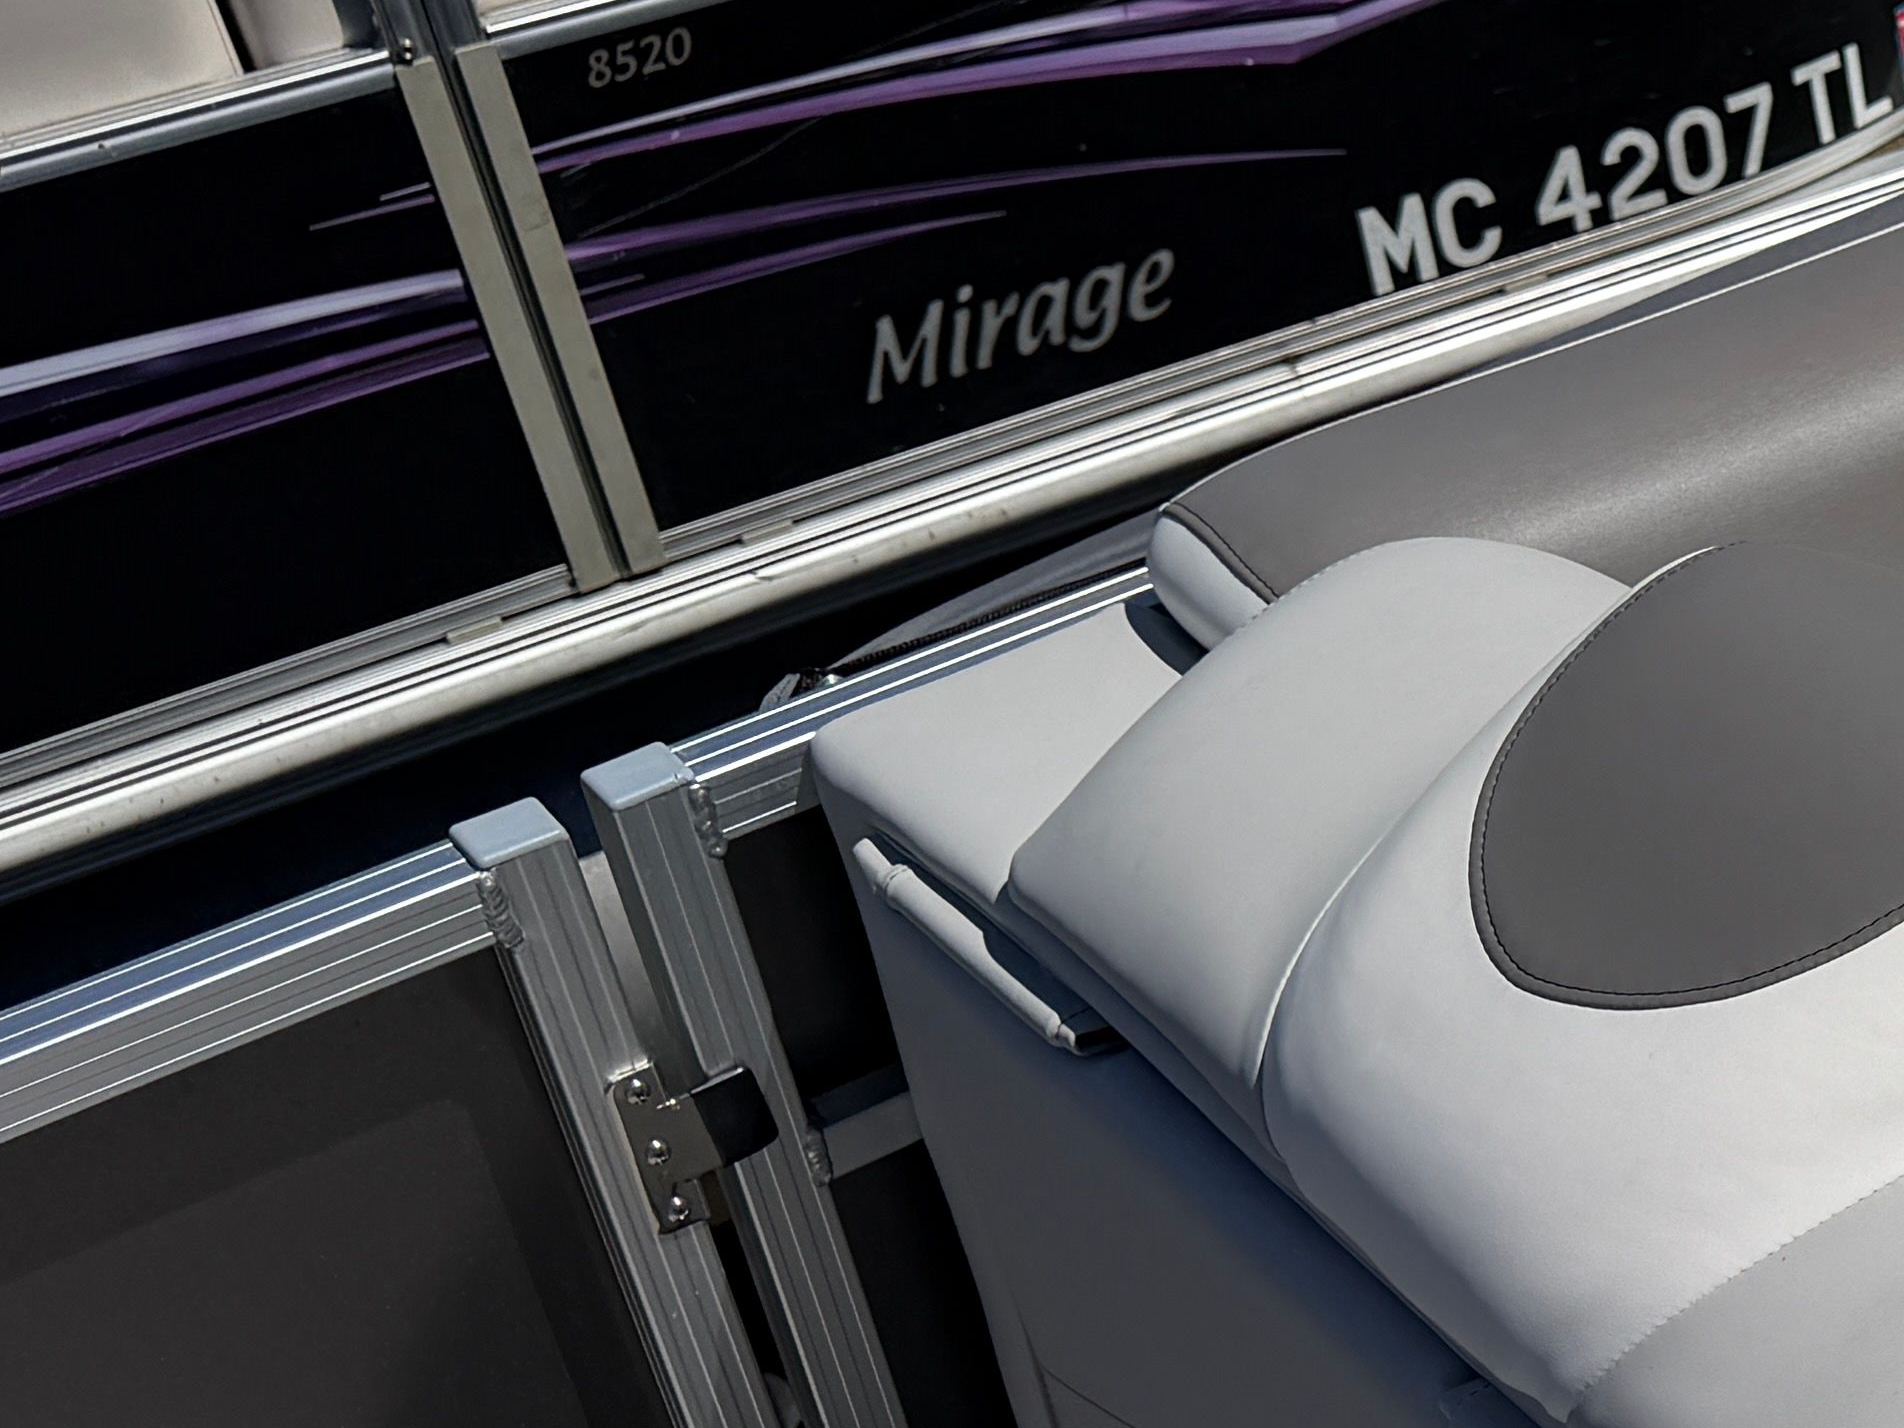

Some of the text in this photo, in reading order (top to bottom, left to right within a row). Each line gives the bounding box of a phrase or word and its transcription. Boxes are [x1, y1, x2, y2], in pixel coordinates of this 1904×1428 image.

[588, 26, 692, 88] 8520
[1355, 42, 1893, 296] MC 4207 TL
[866, 248, 1175, 404] Mirage
